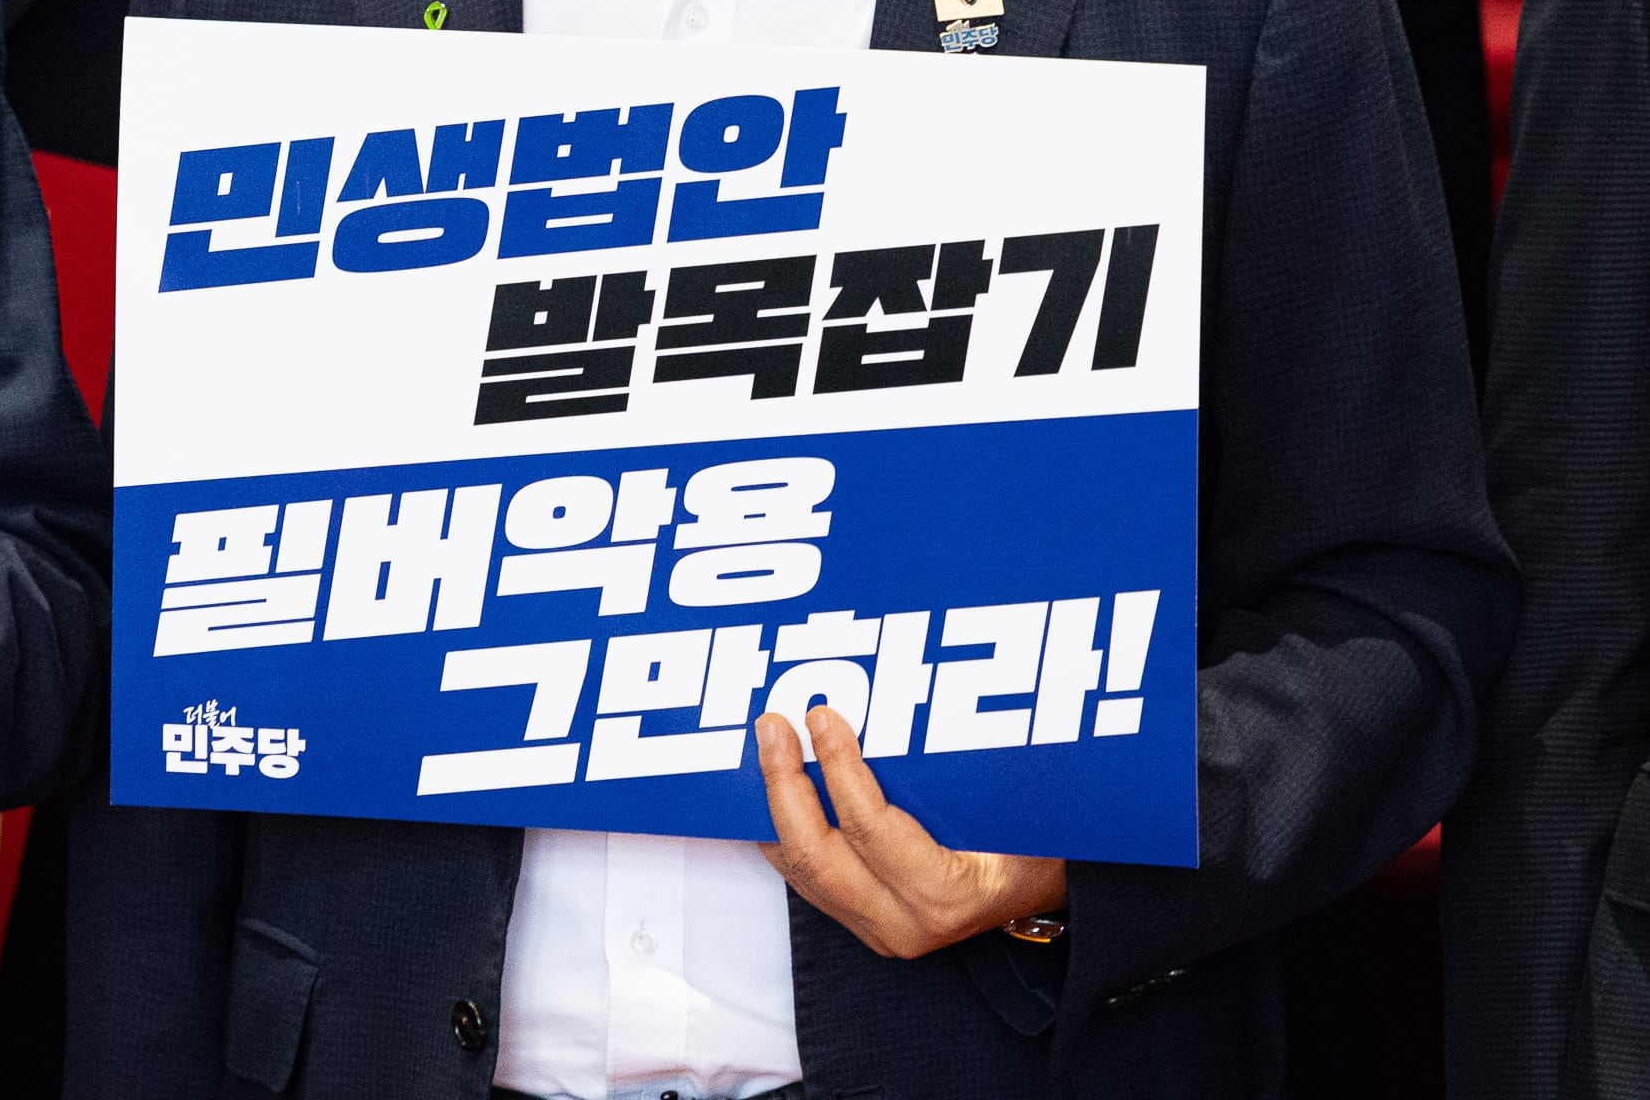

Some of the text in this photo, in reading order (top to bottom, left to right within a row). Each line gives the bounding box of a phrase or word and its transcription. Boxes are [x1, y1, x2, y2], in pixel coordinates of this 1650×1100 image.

[158, 86, 848, 293] 민생법안
[473, 224, 1161, 426] 발목잡기
[153, 456, 837, 657] 필버악용
[162, 723, 307, 779] 민주당
[183, 699, 237, 729] 더불어
[416, 589, 1162, 797] 그만하라!
